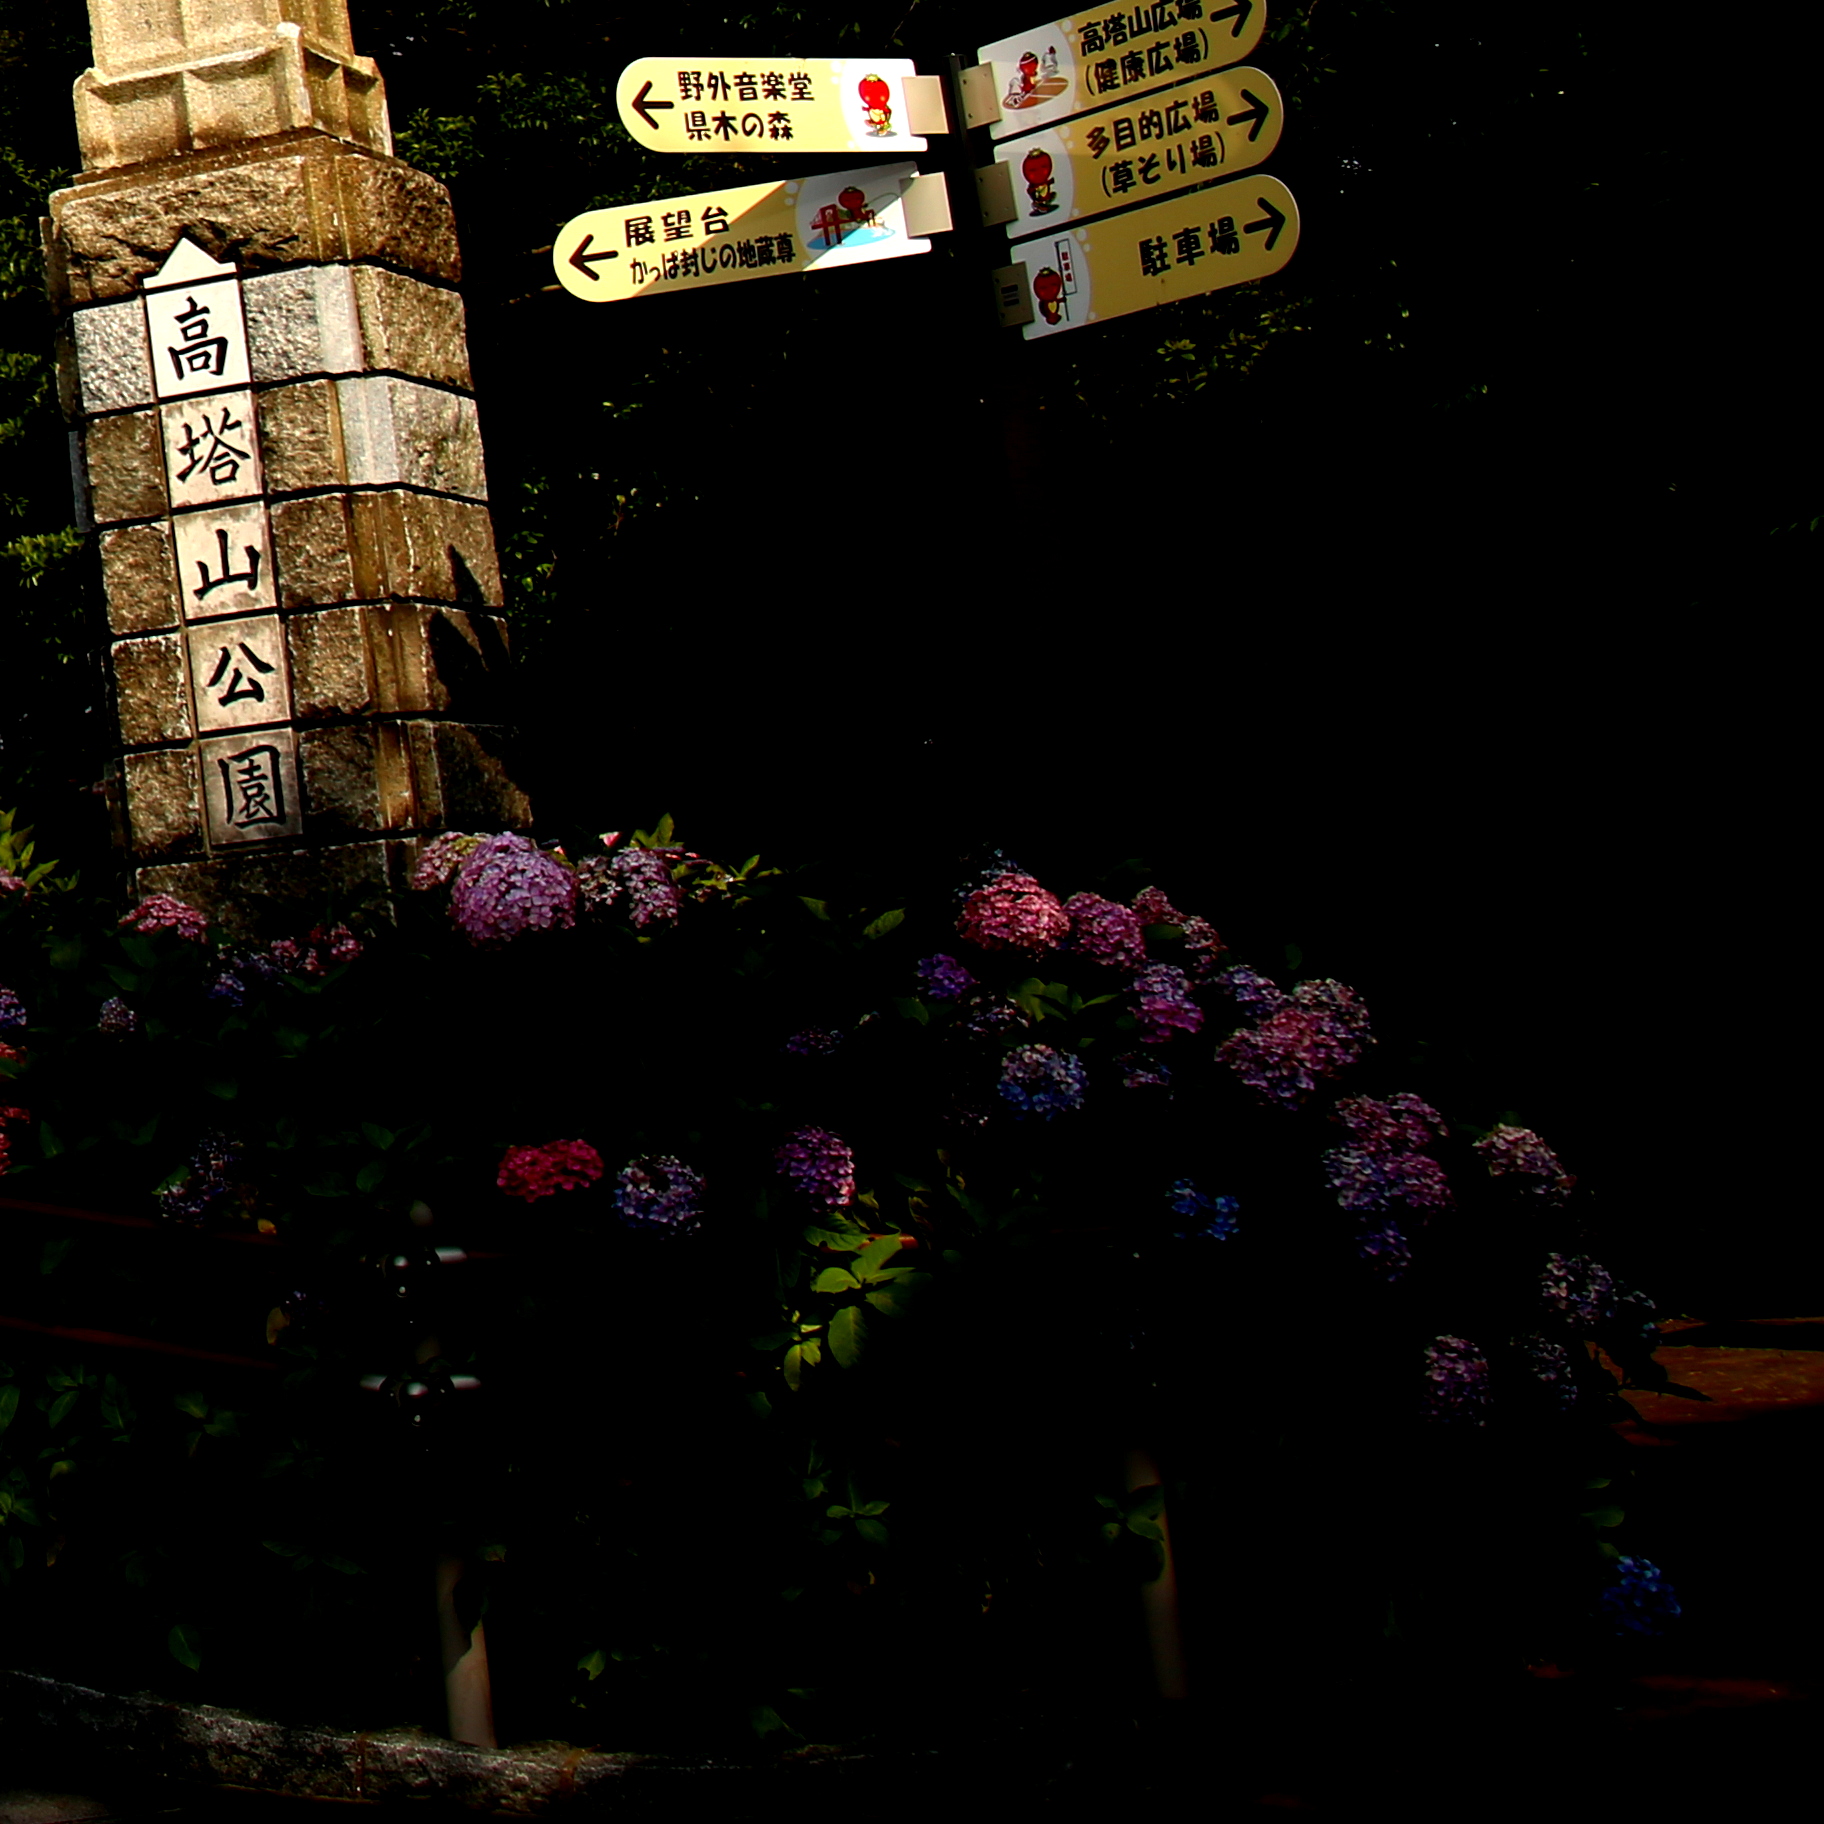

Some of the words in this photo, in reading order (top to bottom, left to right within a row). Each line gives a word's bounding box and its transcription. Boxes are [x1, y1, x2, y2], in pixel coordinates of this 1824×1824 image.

[677, 71, 815, 101] 野外音楽堂
[1085, 27, 1208, 96] (健康広場)
[684, 110, 793, 141] 県木の森
[1086, 90, 1220, 159] 多目的広場
[1101, 131, 1225, 198] (草そり場)
[624, 206, 730, 248] 展望台
[1138, 216, 1240, 277] 駐車場
[630, 233, 796, 285] かっぱ封じの地蔵尊
[168, 296, 286, 830] 高塔山公園
